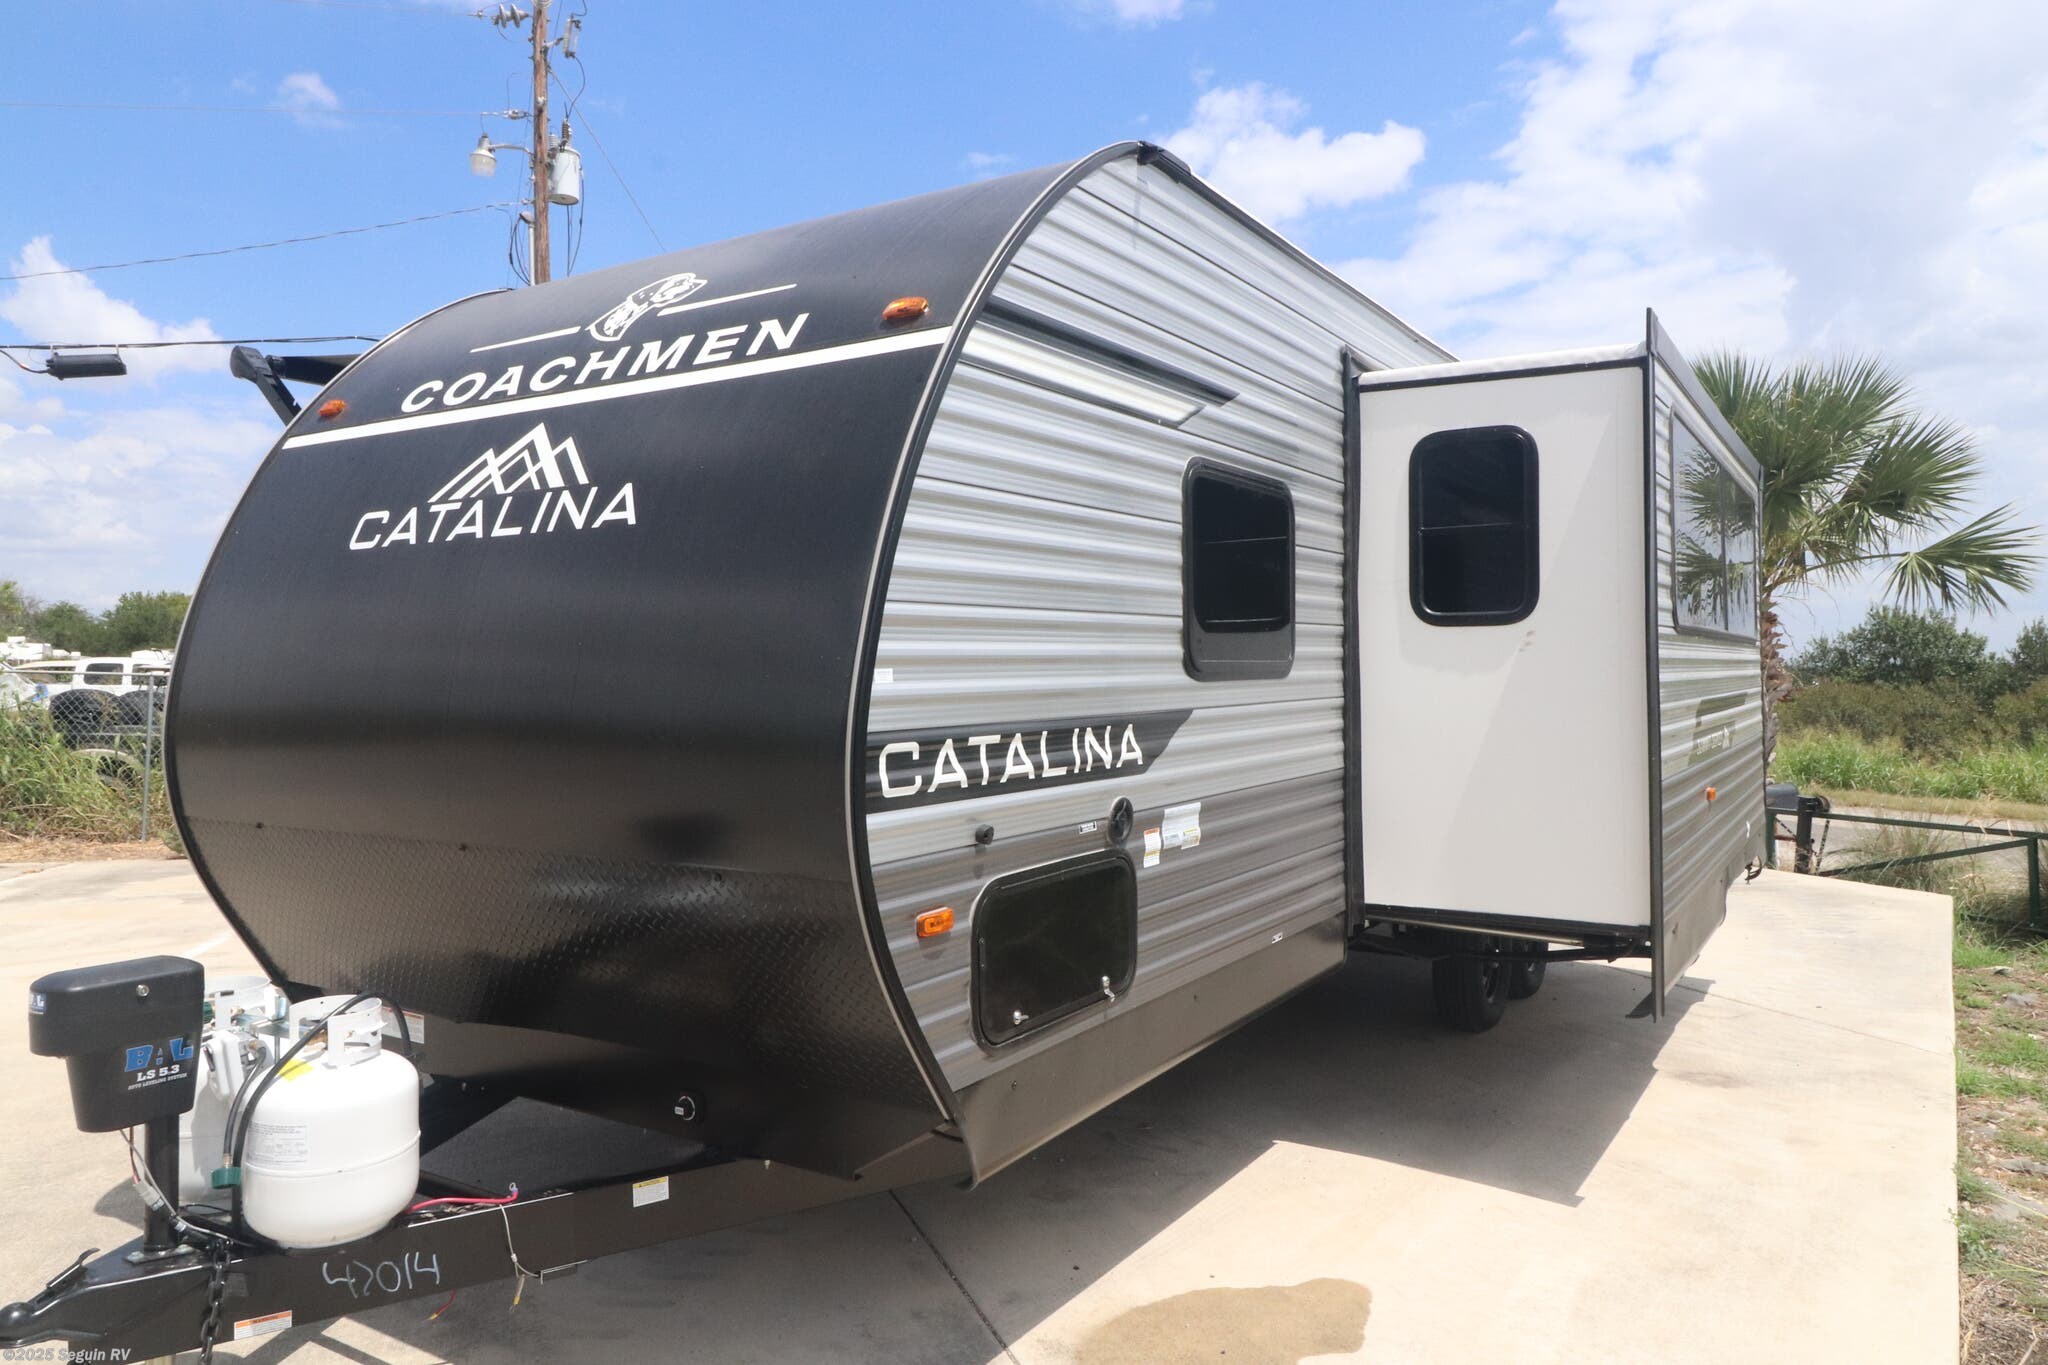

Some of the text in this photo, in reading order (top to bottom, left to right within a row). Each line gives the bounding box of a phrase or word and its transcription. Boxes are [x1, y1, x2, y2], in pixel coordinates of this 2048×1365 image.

[401, 313, 809, 413] COACHMEN
[349, 483, 637, 550] CATALINA
[879, 723, 1143, 798] CATALINA
[136, 1069, 156, 1082] LS
